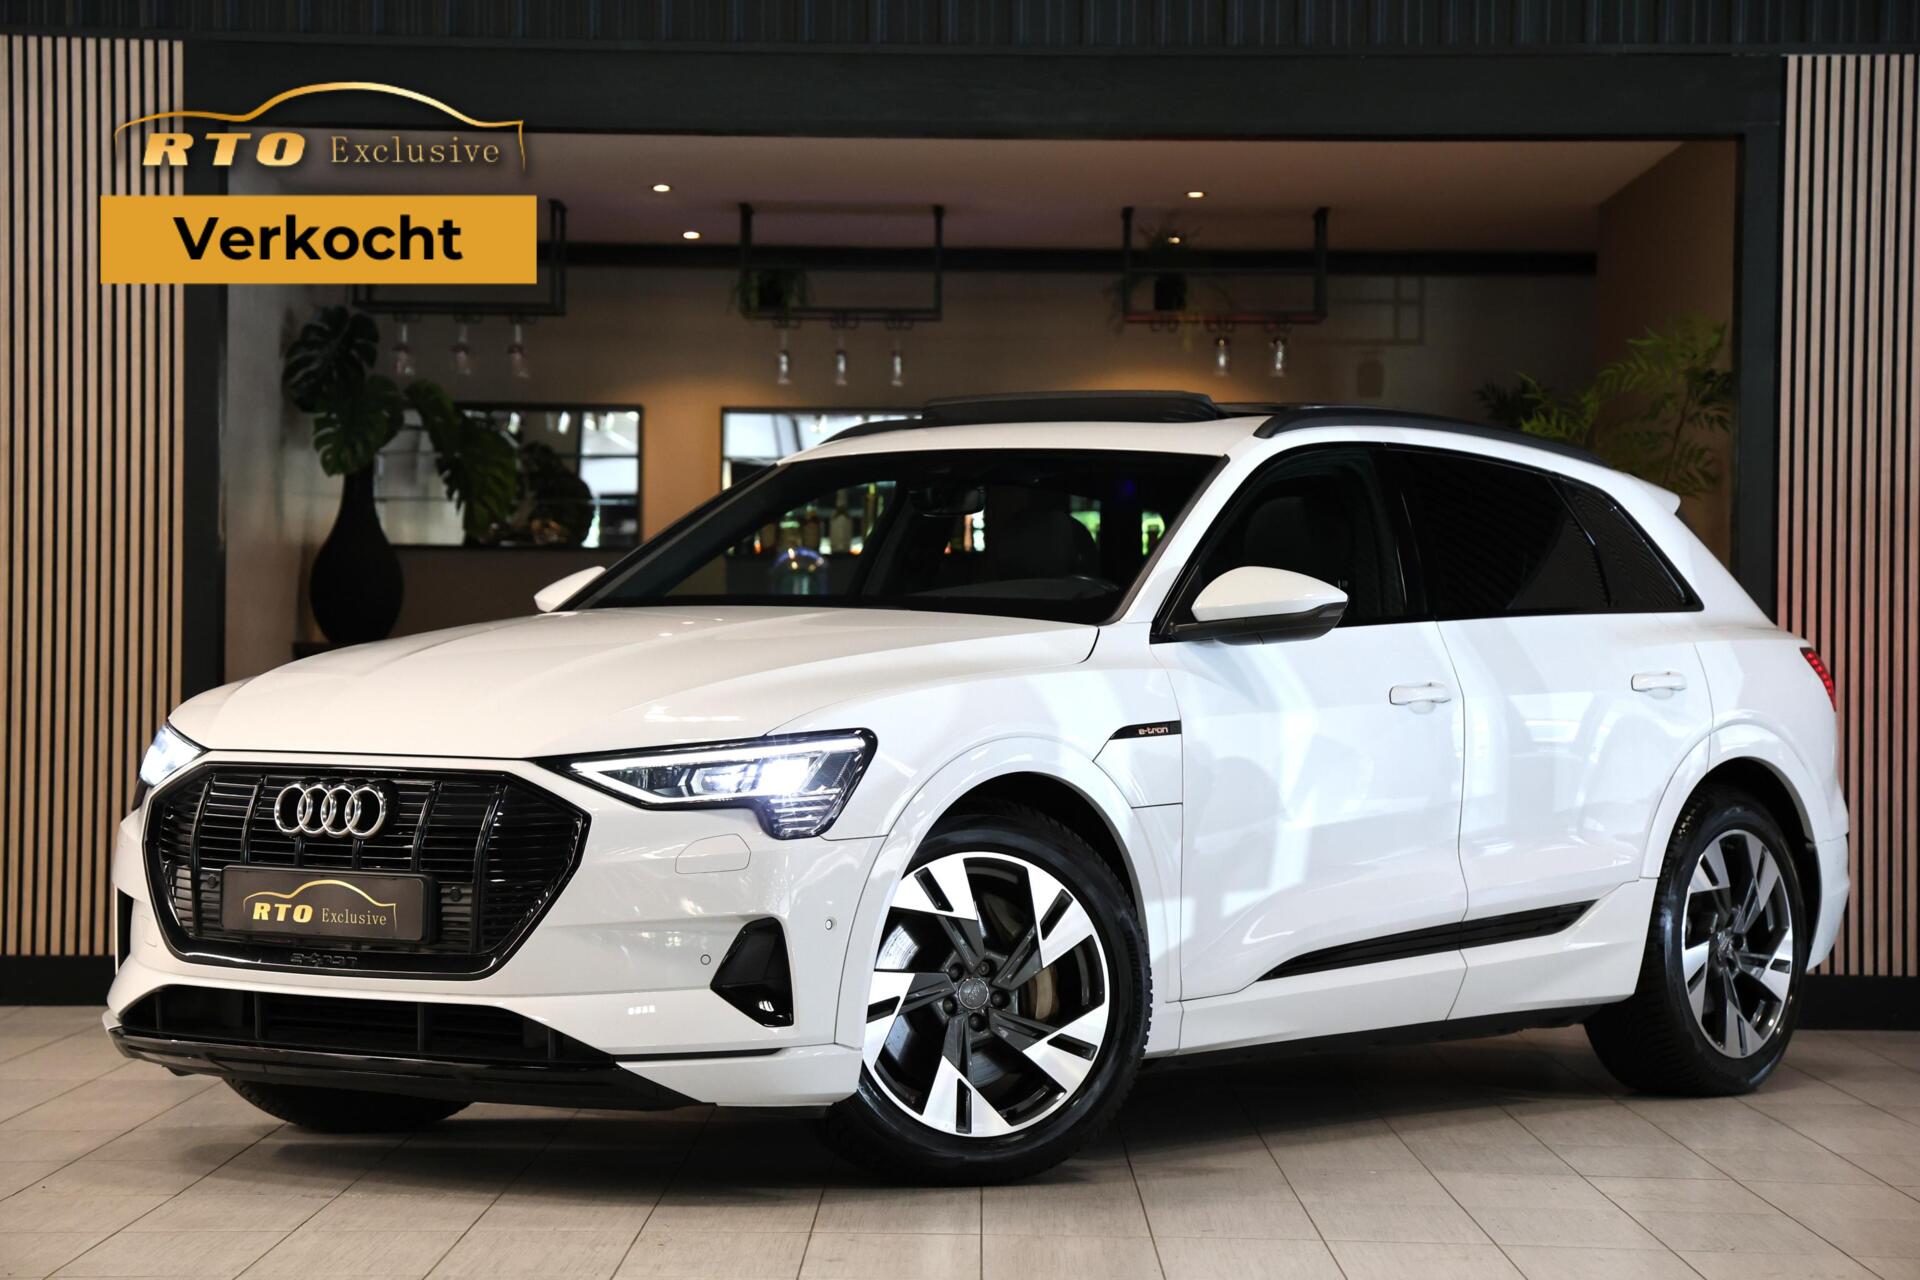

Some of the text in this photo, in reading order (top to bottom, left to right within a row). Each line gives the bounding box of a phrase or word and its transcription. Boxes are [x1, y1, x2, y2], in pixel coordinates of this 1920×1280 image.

[1138, 726, 1169, 735] e-tron
[252, 902, 387, 926] RTO Exclusive
